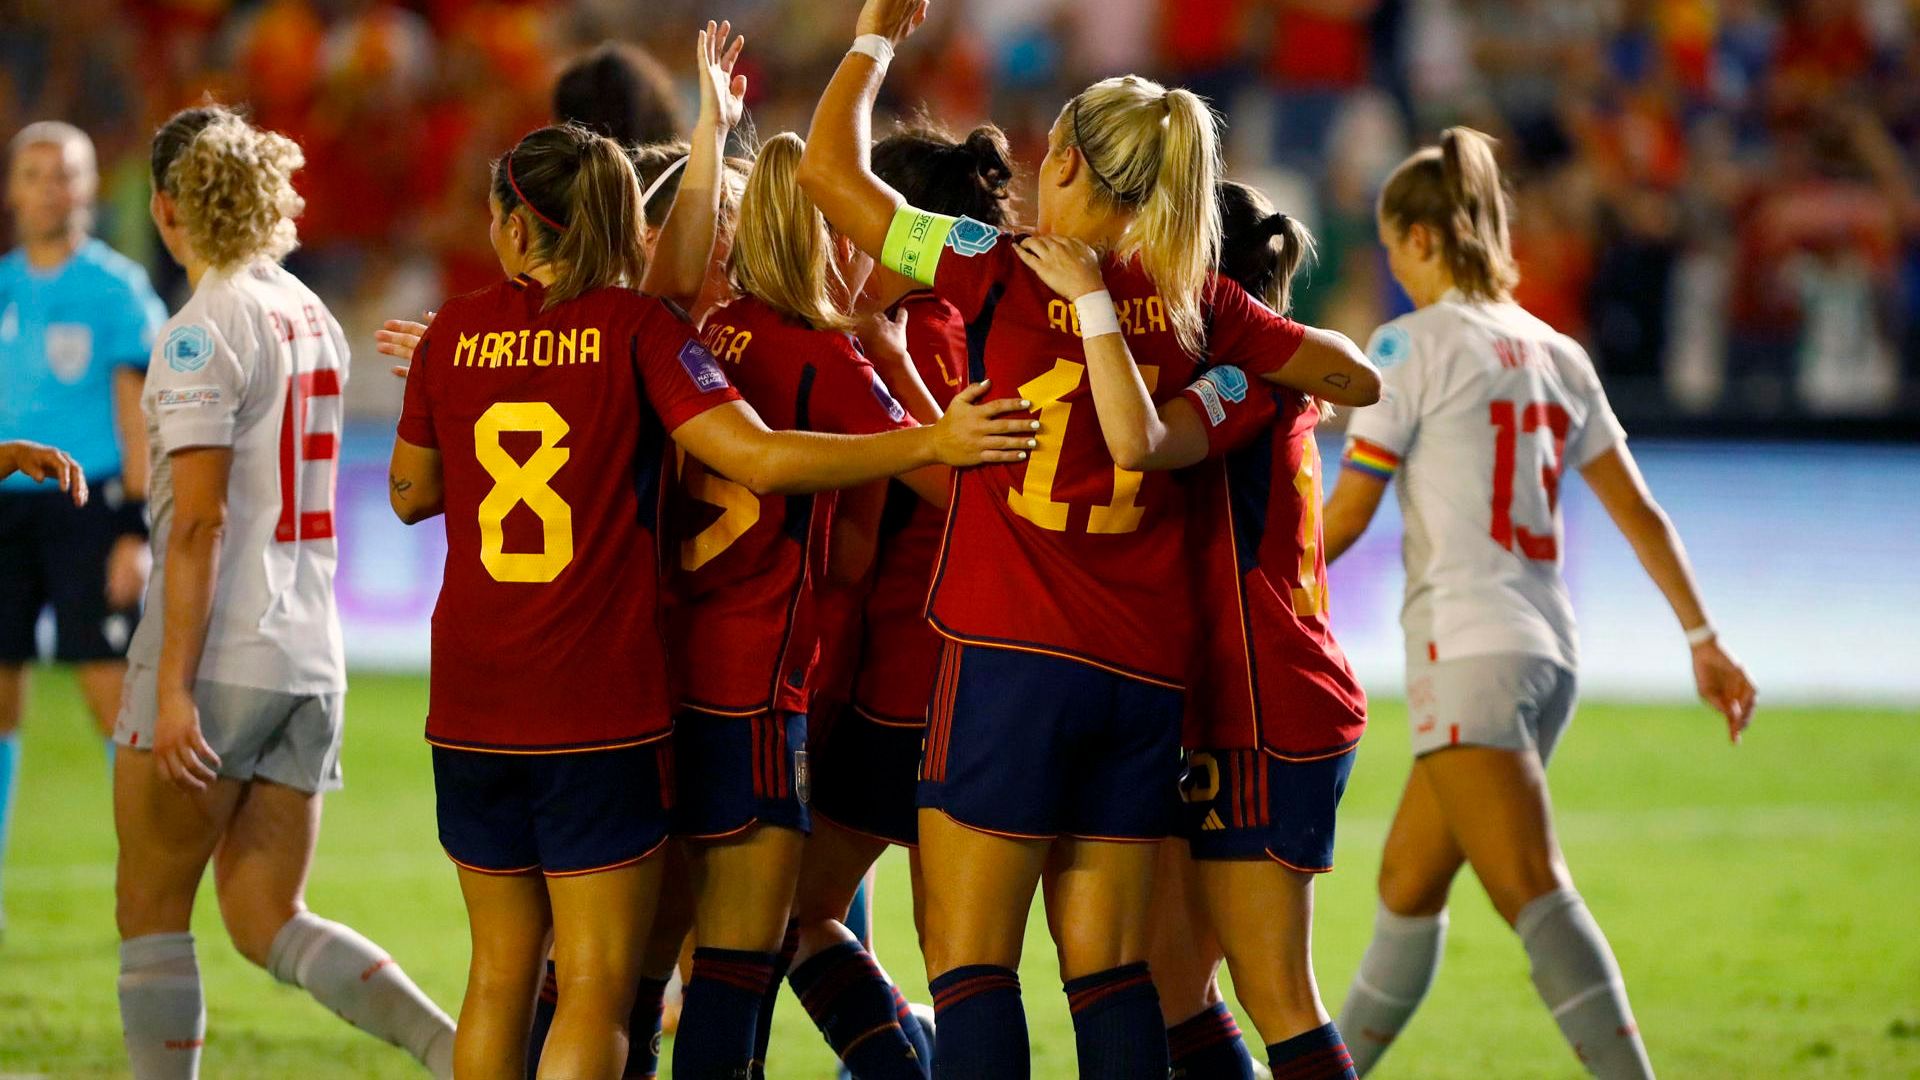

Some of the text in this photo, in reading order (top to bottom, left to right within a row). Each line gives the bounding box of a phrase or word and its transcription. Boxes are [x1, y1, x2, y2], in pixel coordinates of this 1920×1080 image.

[453, 327, 600, 369] MARIONA
[1048, 296, 1167, 338] ALXIA
[474, 401, 574, 583] 8
[1007, 357, 1160, 535] 11
[1489, 400, 1571, 561] 13
